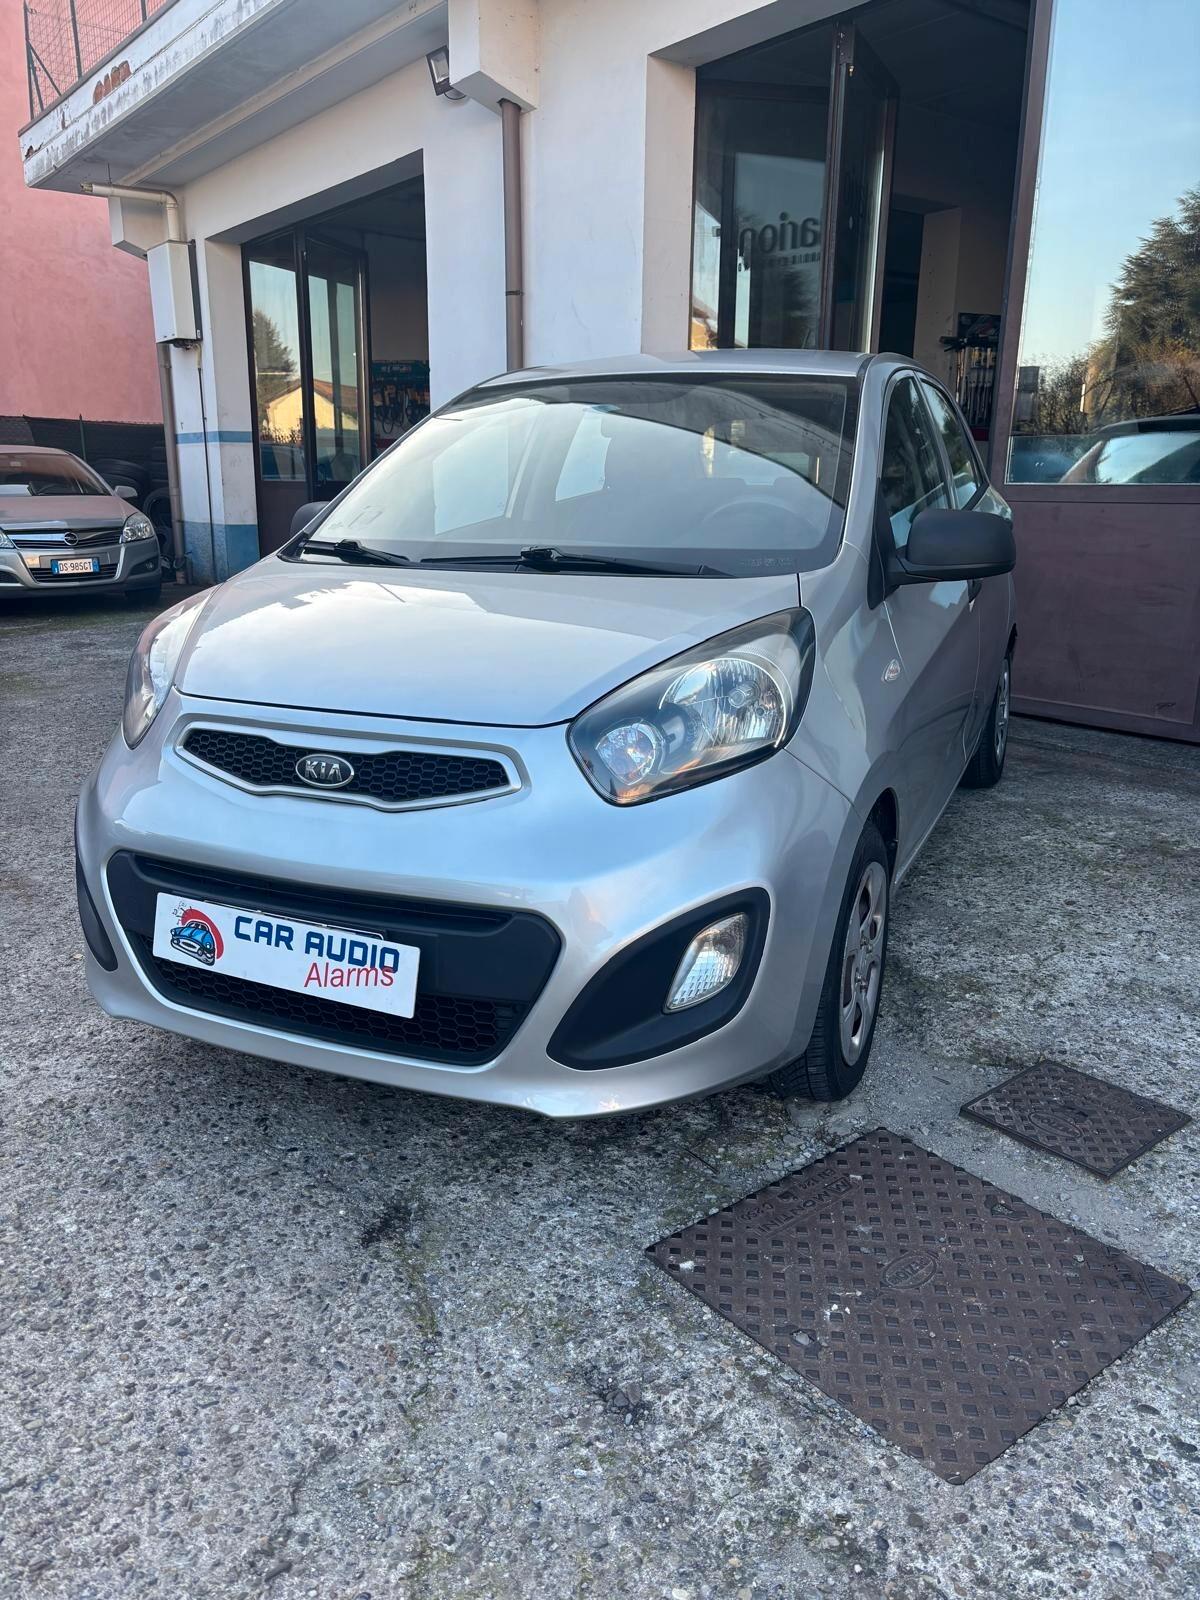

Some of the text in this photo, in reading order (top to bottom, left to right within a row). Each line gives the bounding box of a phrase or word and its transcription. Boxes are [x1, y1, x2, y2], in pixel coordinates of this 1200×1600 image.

[59, 561, 92, 572] DS 985GT
[304, 760, 343, 782] KIA
[234, 915, 400, 974] CAR AUDIO
[304, 962, 394, 988] Alarms
[754, 1189, 831, 1236] MONTINI
